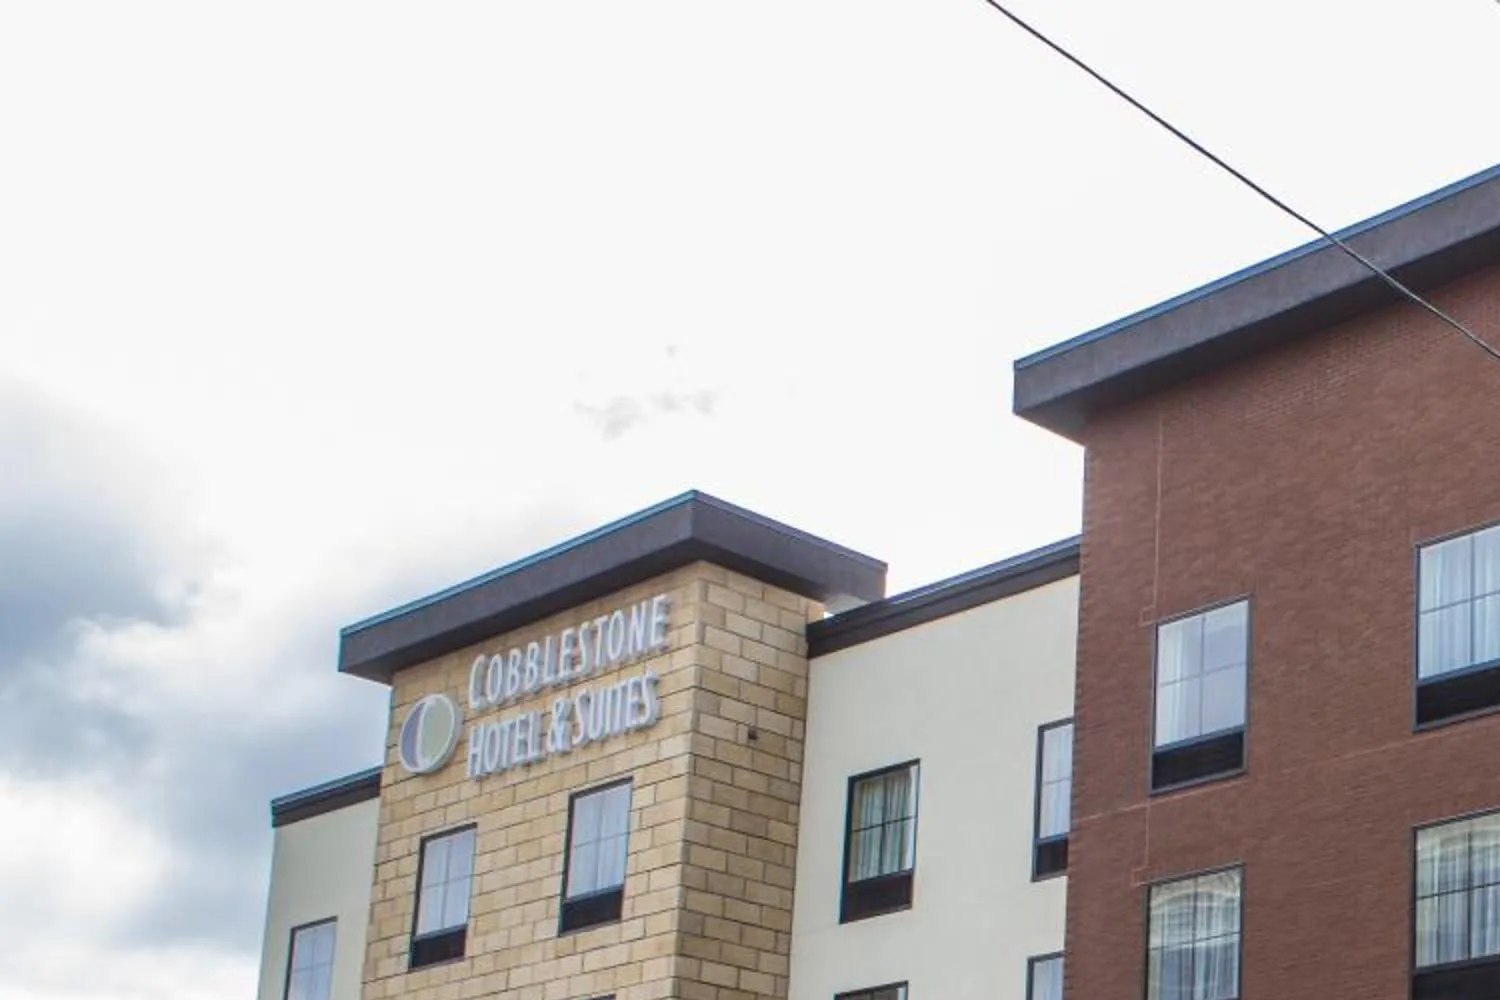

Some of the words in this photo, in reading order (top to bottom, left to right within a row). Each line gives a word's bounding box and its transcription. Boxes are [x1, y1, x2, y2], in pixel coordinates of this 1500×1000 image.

[469, 593, 670, 710] COBBLESTONE
[467, 710, 543, 780] HOTEL
[547, 697, 573, 754] &
[571, 670, 660, 747] SUITES
